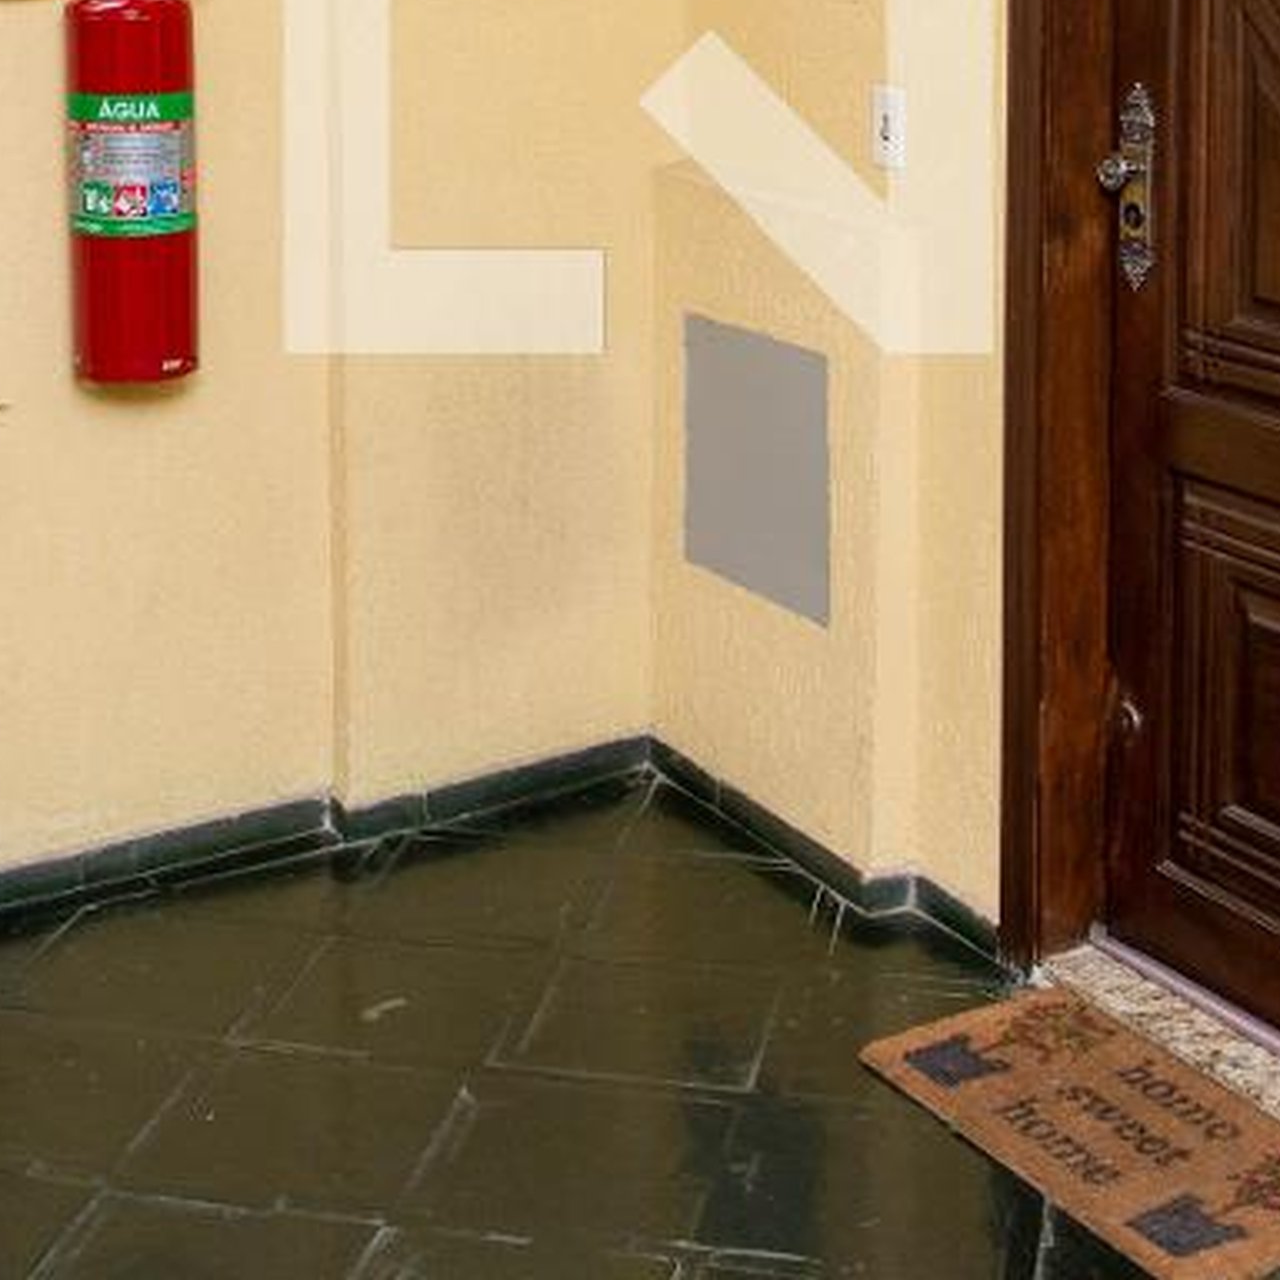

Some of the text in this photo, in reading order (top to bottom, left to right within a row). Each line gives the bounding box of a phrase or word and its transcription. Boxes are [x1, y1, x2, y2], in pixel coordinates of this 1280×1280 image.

[996, 1096, 1120, 1188] home
[1056, 1084, 1190, 1167] sweet
[1115, 1059, 1240, 1142] home
